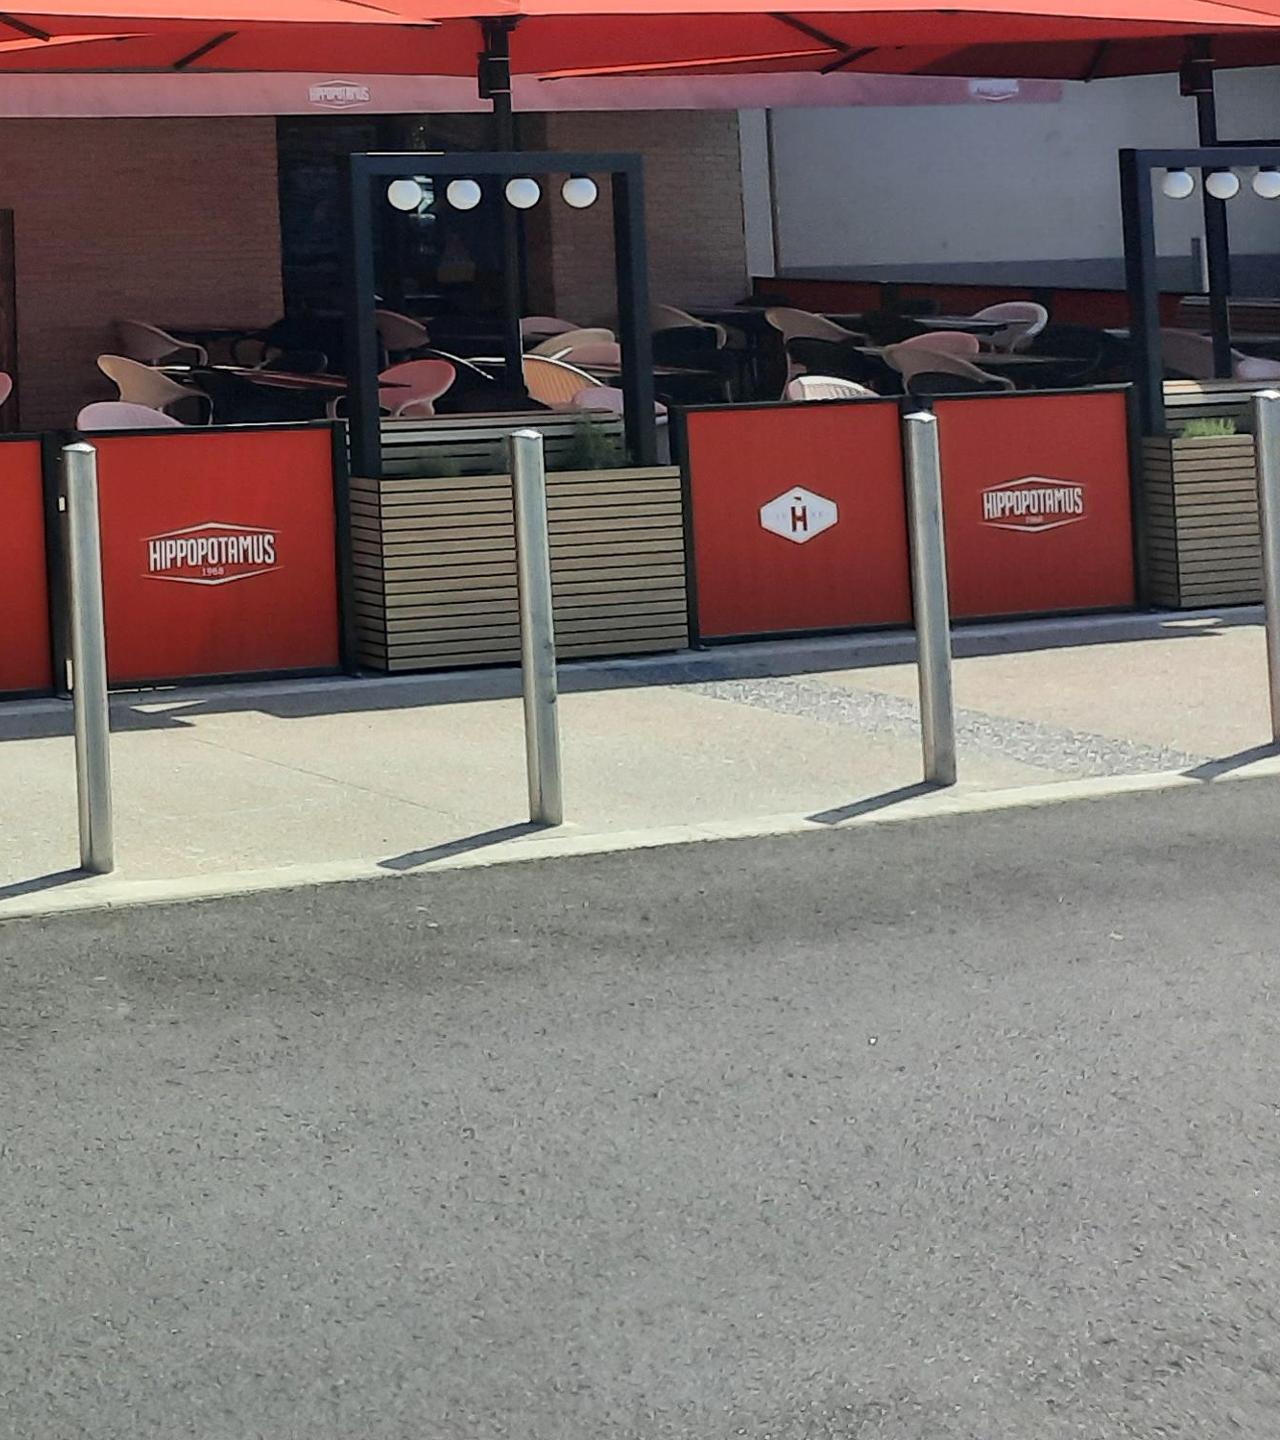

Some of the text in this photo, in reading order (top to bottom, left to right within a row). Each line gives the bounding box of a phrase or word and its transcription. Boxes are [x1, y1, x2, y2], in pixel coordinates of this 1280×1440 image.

[791, 505, 808, 533] H
[983, 487, 1083, 521] HIPPOPOTAMUS
[148, 534, 275, 572] HIPPOPOTAMUS
